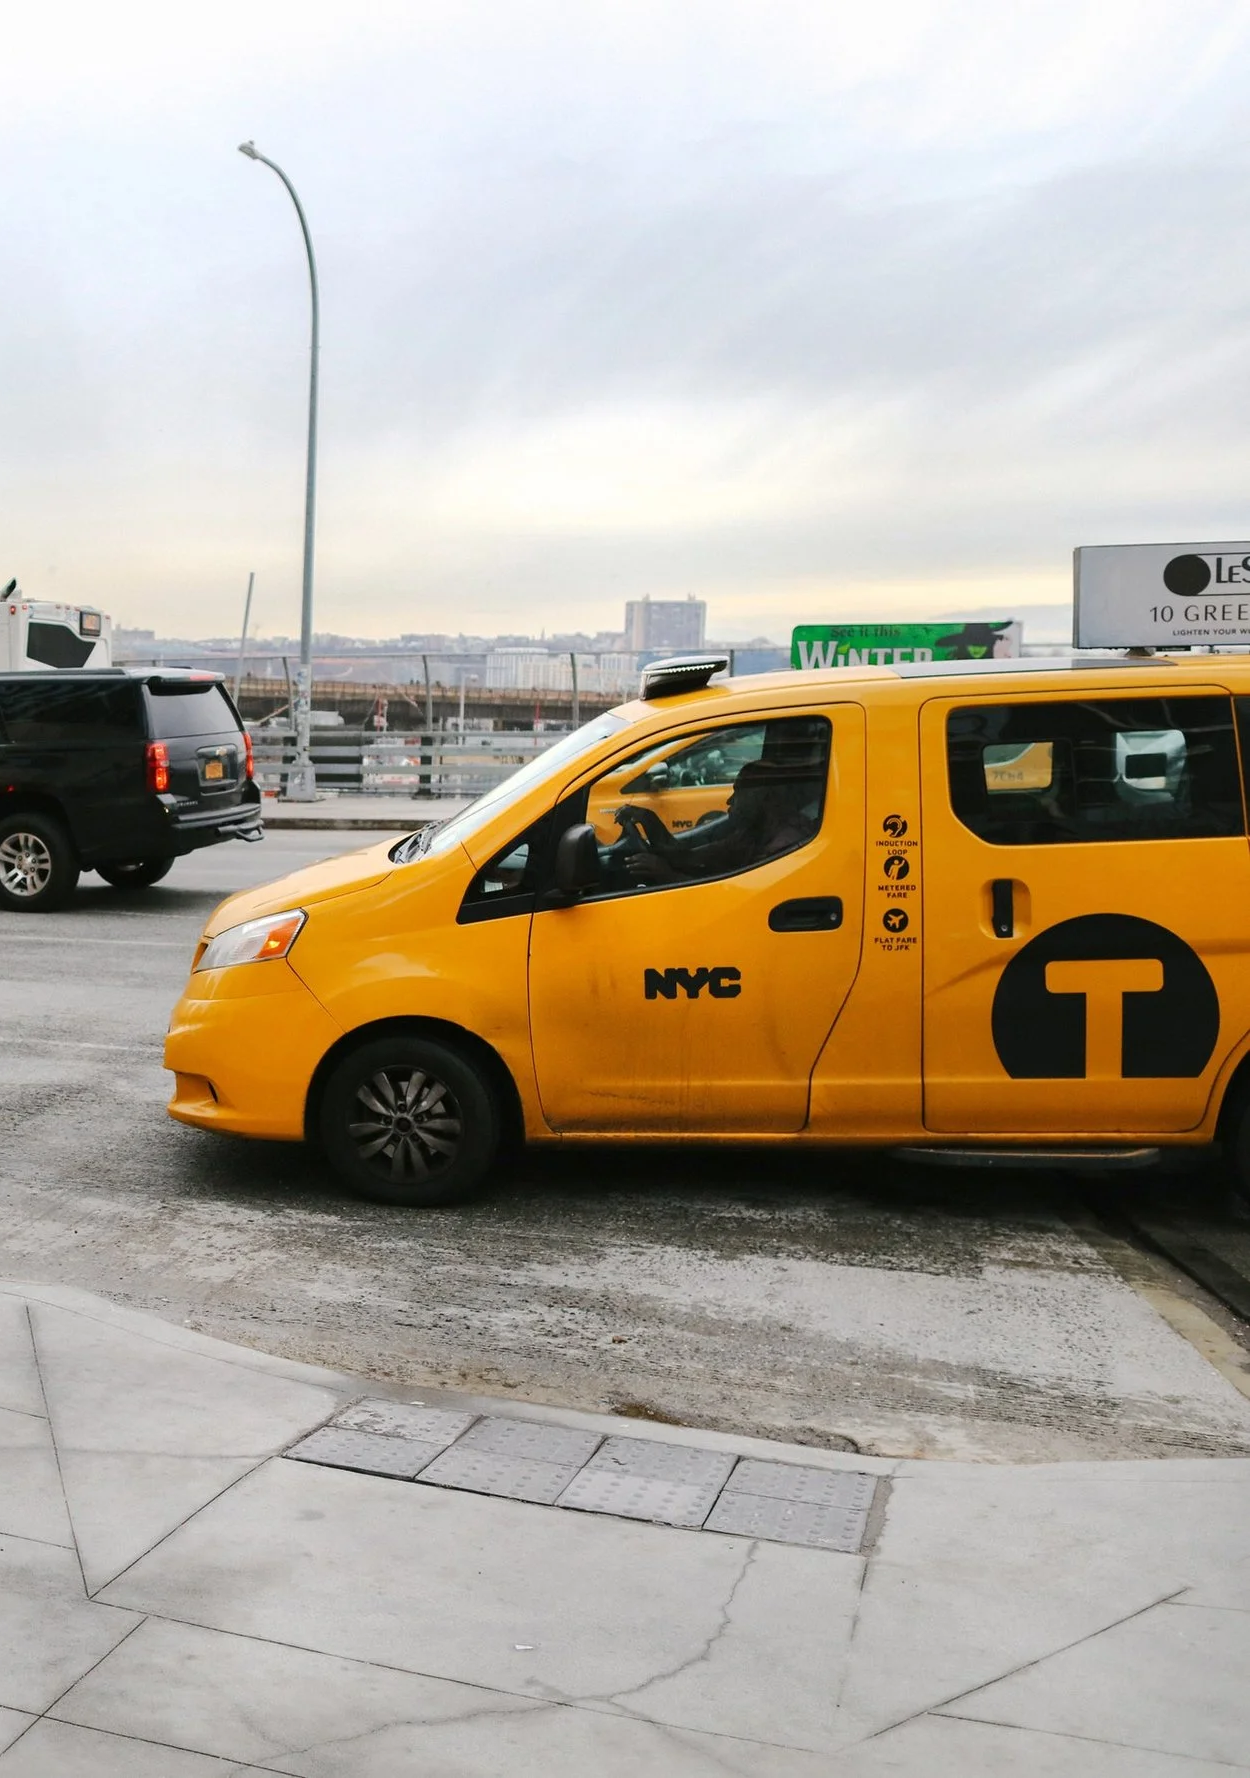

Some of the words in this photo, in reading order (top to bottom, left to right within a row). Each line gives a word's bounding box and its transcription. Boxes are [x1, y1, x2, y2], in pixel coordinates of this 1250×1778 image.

[1150, 605, 1174, 622] 10
[830, 626, 853, 638] See
[860, 626, 869, 637] it
[874, 625, 899, 637] this
[672, 820, 693, 828] NYC
[644, 967, 742, 1000] NYC
[1044, 958, 1165, 1080] T
